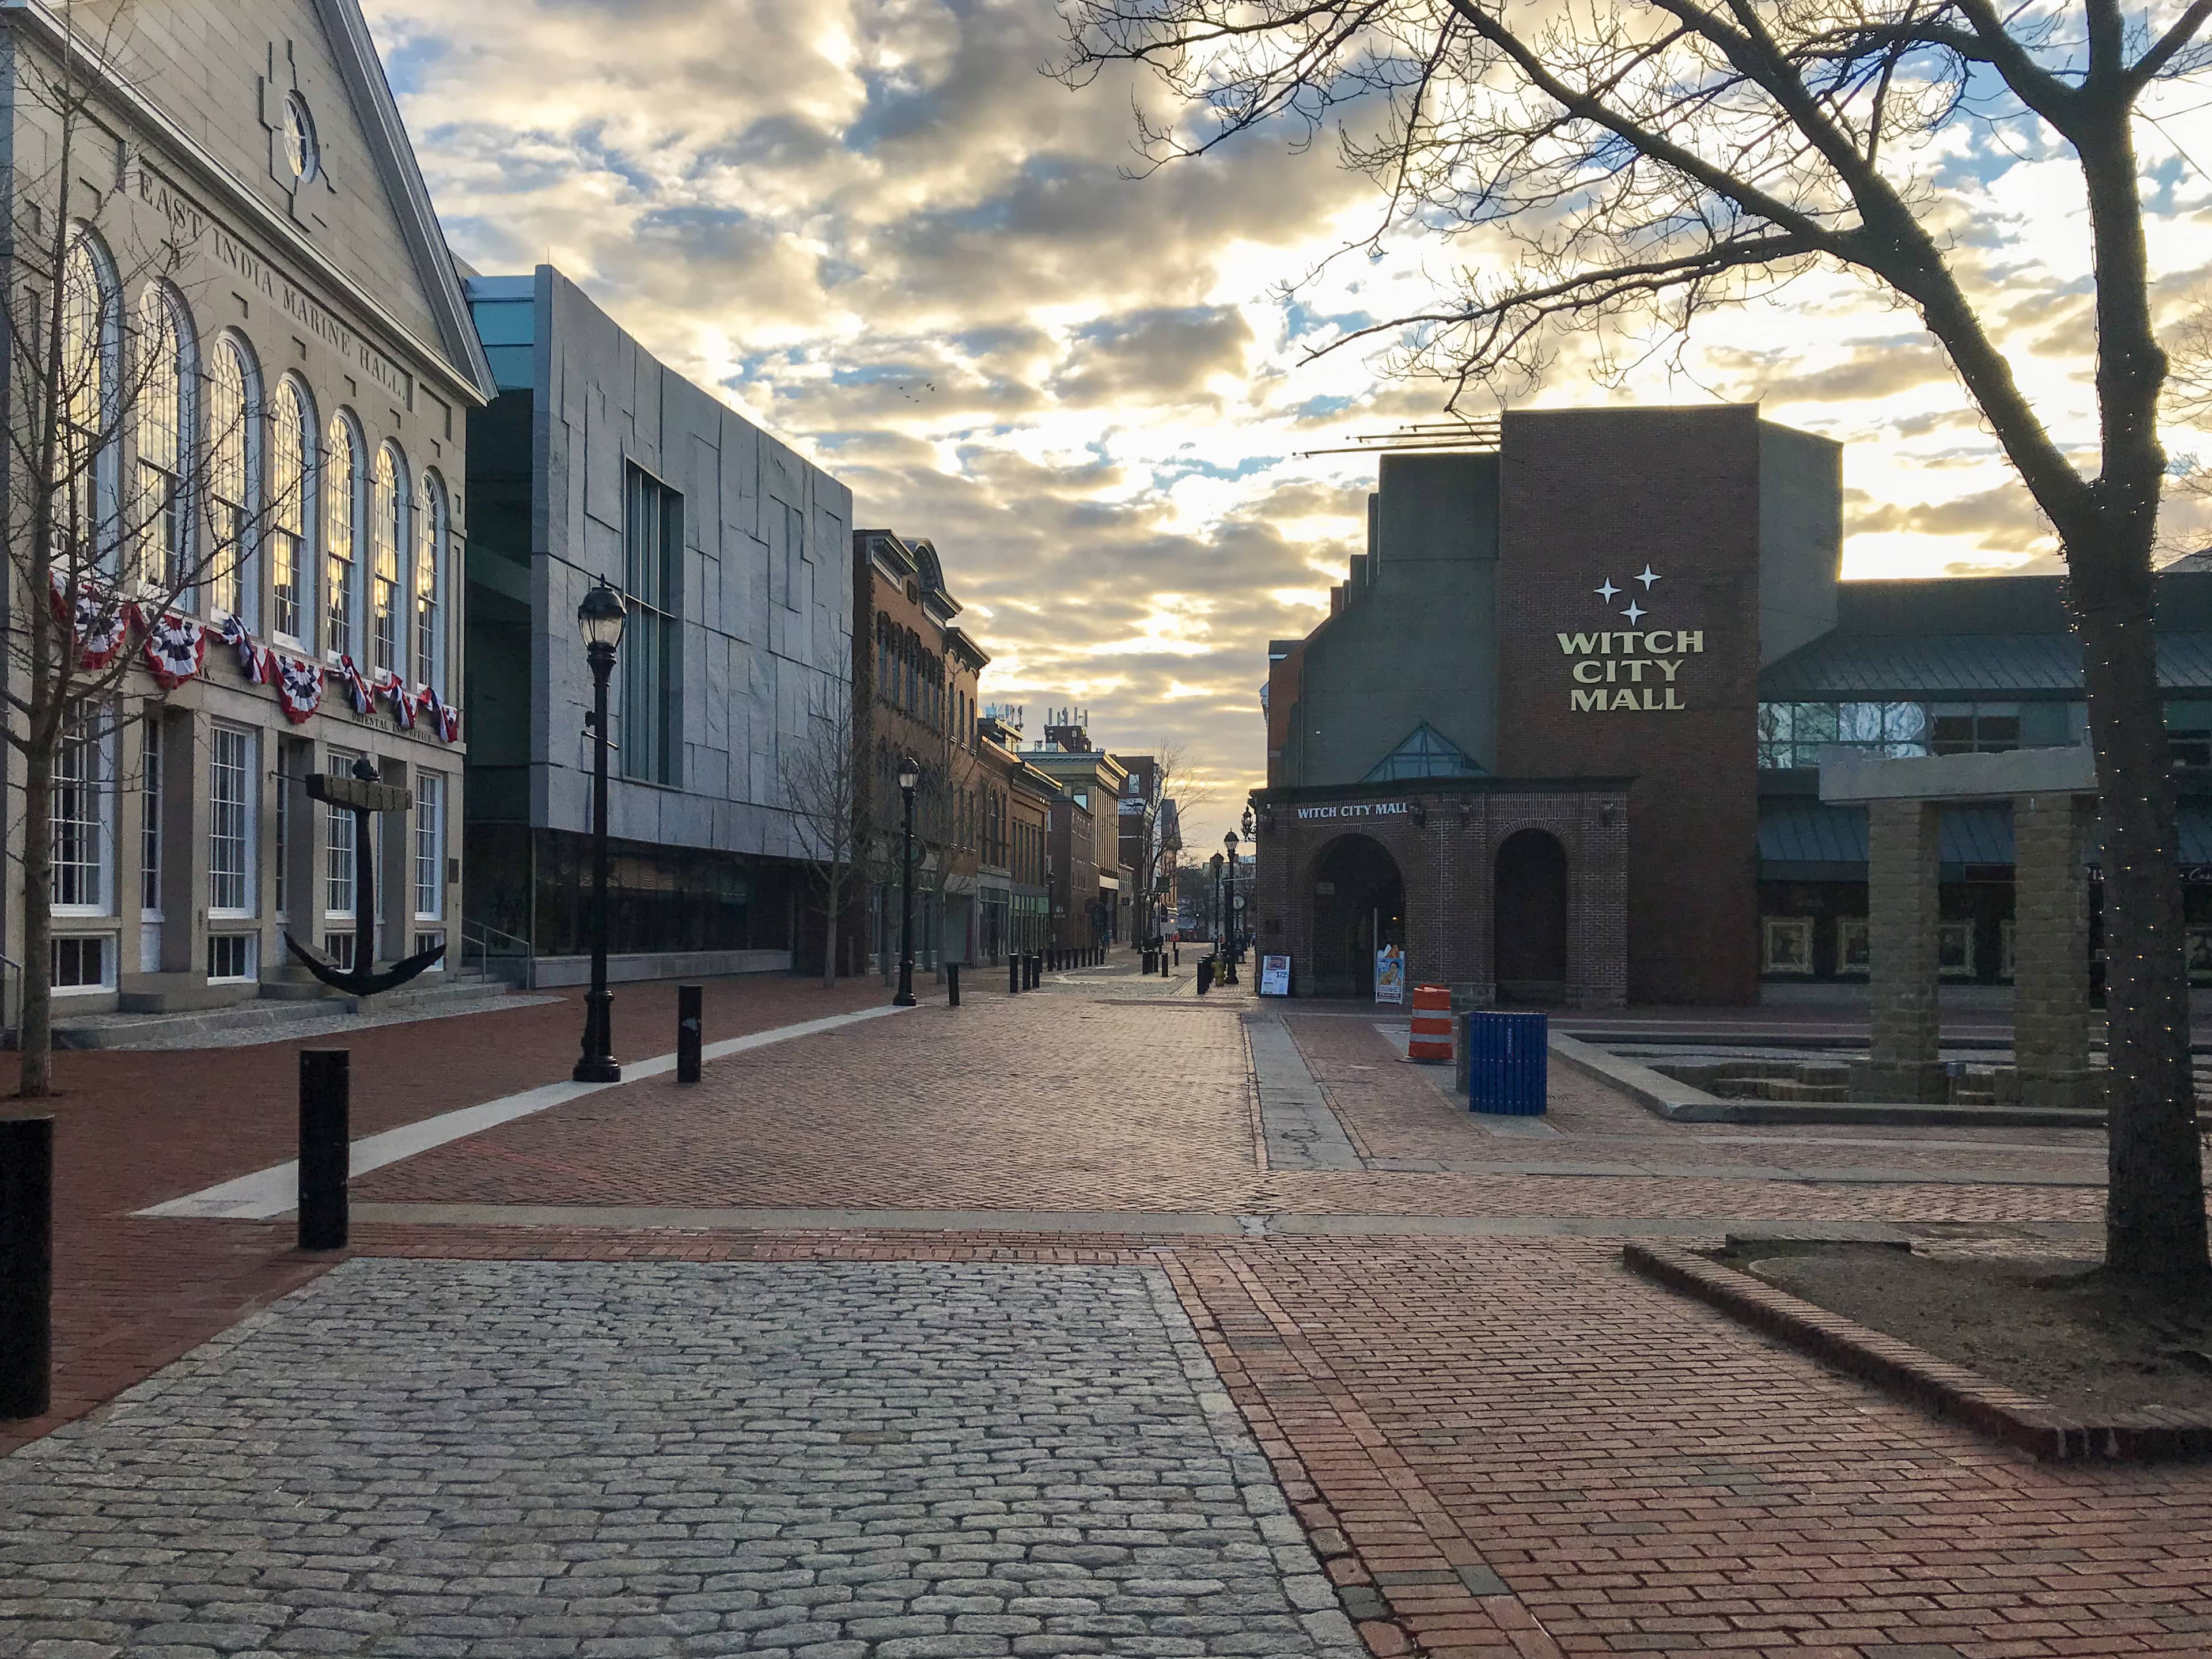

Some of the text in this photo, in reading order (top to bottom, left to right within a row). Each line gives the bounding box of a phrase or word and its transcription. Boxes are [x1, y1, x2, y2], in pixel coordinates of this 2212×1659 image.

[139, 169, 202, 238] EAST
[213, 227, 275, 300] INDIA
[283, 284, 350, 357] MARINE
[1556, 630, 1703, 655] WITCH
[1573, 659, 1684, 684] CITY
[1571, 688, 1685, 712] MALL
[351, 712, 389, 730] ORIENTAL
[1297, 802, 1408, 819] WITCH CITY MALL
